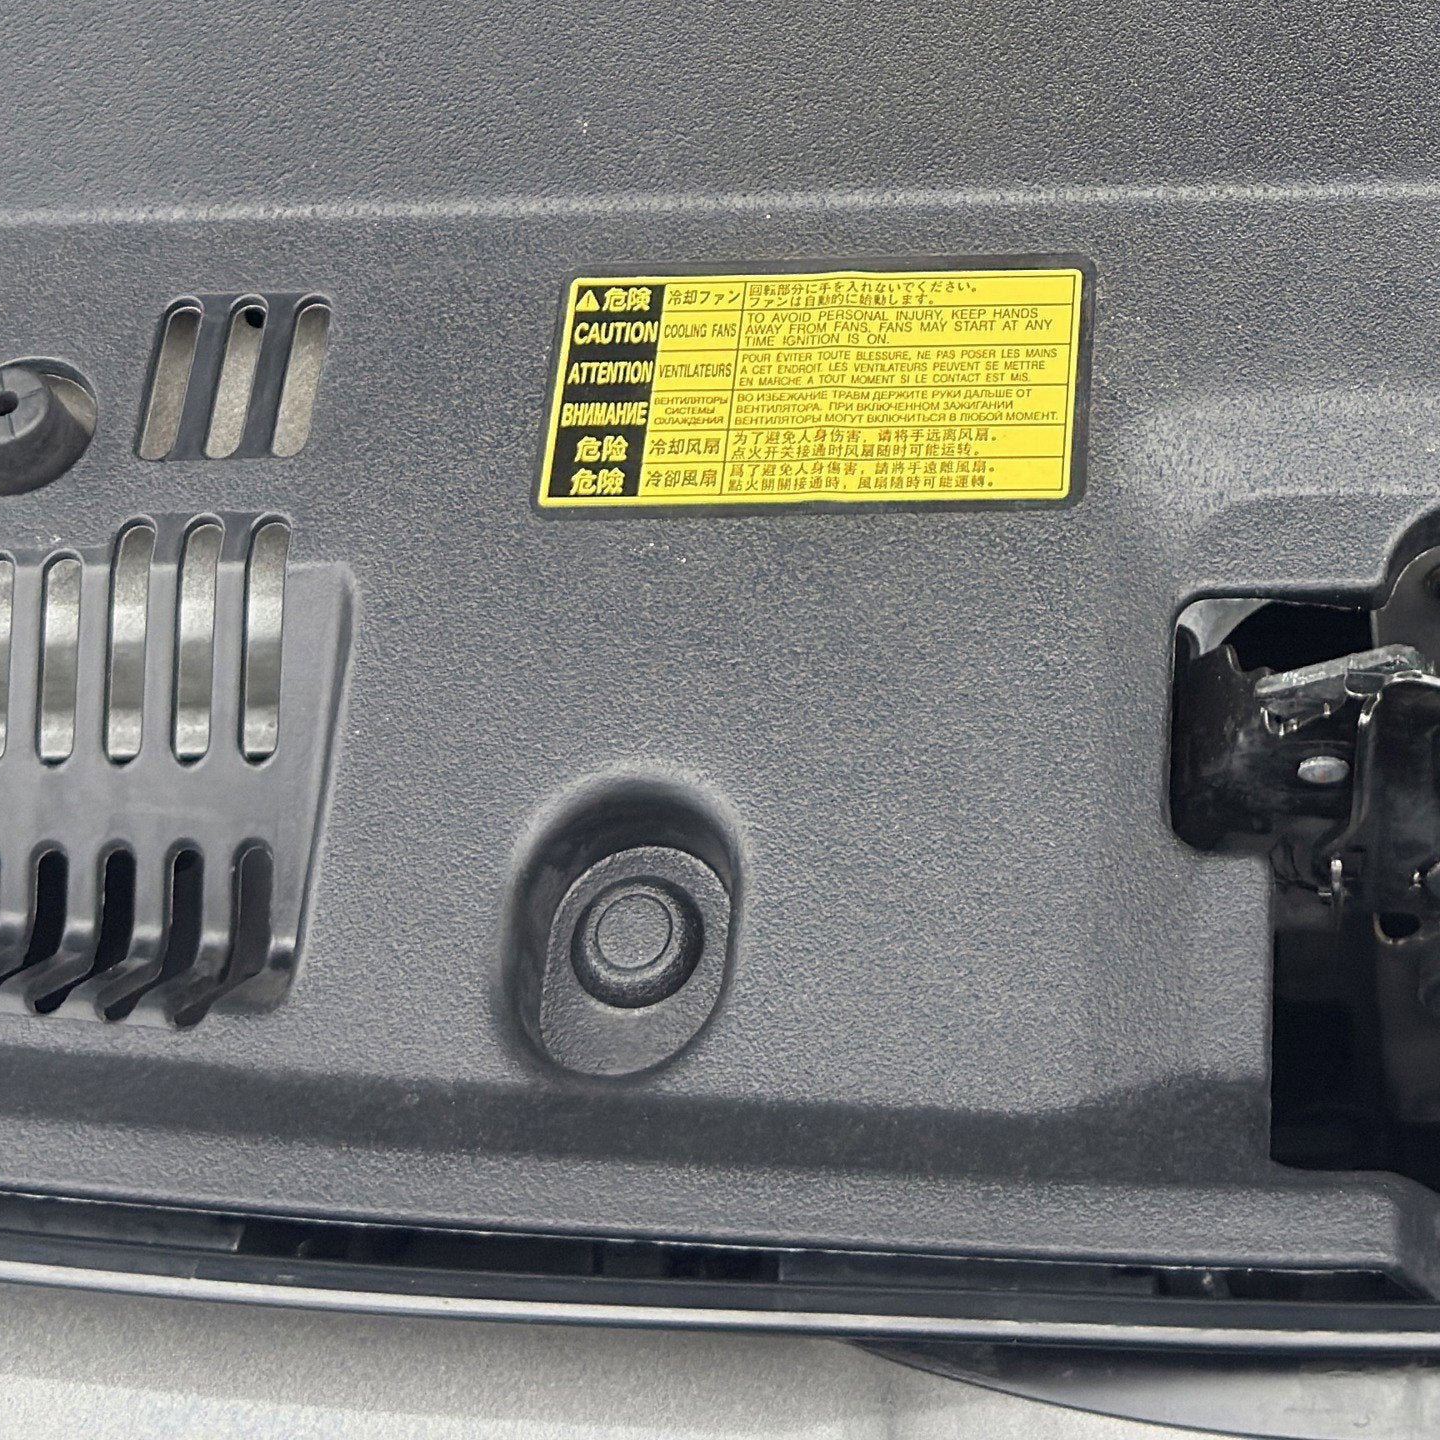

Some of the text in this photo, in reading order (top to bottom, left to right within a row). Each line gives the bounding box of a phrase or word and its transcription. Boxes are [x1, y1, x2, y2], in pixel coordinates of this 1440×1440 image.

[602, 287, 652, 312] 危険
[668, 289, 741, 306] 冷却ファン
[748, 308, 1039, 323] TO AVOID PERSONAL INJURY, KEEP HANDS
[574, 321, 658, 345] CAUTION
[664, 323, 737, 338] COOLING FANS
[745, 324, 782, 335] AWAY
[789, 323, 827, 334] FROM
[879, 321, 912, 333] FANS
[920, 321, 947, 332] MAY
[954, 320, 996, 331] START
[1003, 320, 1018, 331] AT
[1025, 319, 1053, 330] ANY
[745, 333, 890, 347] TIME IGNITION IS ON.
[742, 353, 771, 363] POUR
[818, 351, 851, 361] TOUTE
[856, 351, 911, 361] BLESSURE,
[917, 351, 931, 360] NE
[937, 350, 956, 360] PAS
[961, 350, 996, 359] POSER
[1001, 349, 1020, 358] LES
[1026, 348, 1057, 358] MAINS
[567, 360, 654, 385] ATTENTION
[659, 362, 732, 378] VENTILATEURS
[752, 365, 772, 374] CET
[829, 362, 848, 372] LES
[854, 362, 928, 372] VENTILATEURS
[933, 361, 980, 371] PEUVENT
[985, 361, 999, 370] SE
[1004, 361, 1046, 370] METTRE
[739, 378, 753, 386] EN
[759, 377, 802, 386] MARCHE
[819, 375, 846, 384] TOUT
[851, 374, 895, 384] MOMENT
[901, 374, 910, 383] SI
[915, 374, 927, 383] LE
[932, 373, 981, 383] CONTACT
[986, 373, 1006, 382] EST
[654, 396, 727, 405] ВЕНТИЛЯТОРЫ
[737, 389, 1032, 402] ВО ИЗБЕЖАНИЕ ТРАВМ ДЕРЖИТЕ РУКИ ДАЛЬШЕ ОТ
[829, 402, 853, 411] ПРИ
[856, 402, 940, 412] ВКЛЮЧЕННОМ
[943, 400, 1014, 410] ЗАЖИГАНИИ
[560, 402, 649, 427] ВНИМАНИЕ
[654, 417, 723, 426] ОХЛАЖДЕНИЯ
[735, 411, 1058, 425] ВЕНТИЛЯТОРЫ МОГУТ ВКЛЮЧИТЬСЯ В ЛЮБОЙ МОМЕНТ.
[574, 436, 629, 463] 危险
[649, 437, 721, 455] 冷却风扇
[569, 467, 625, 495] 危險
[645, 469, 717, 488] 冷卻風扇
